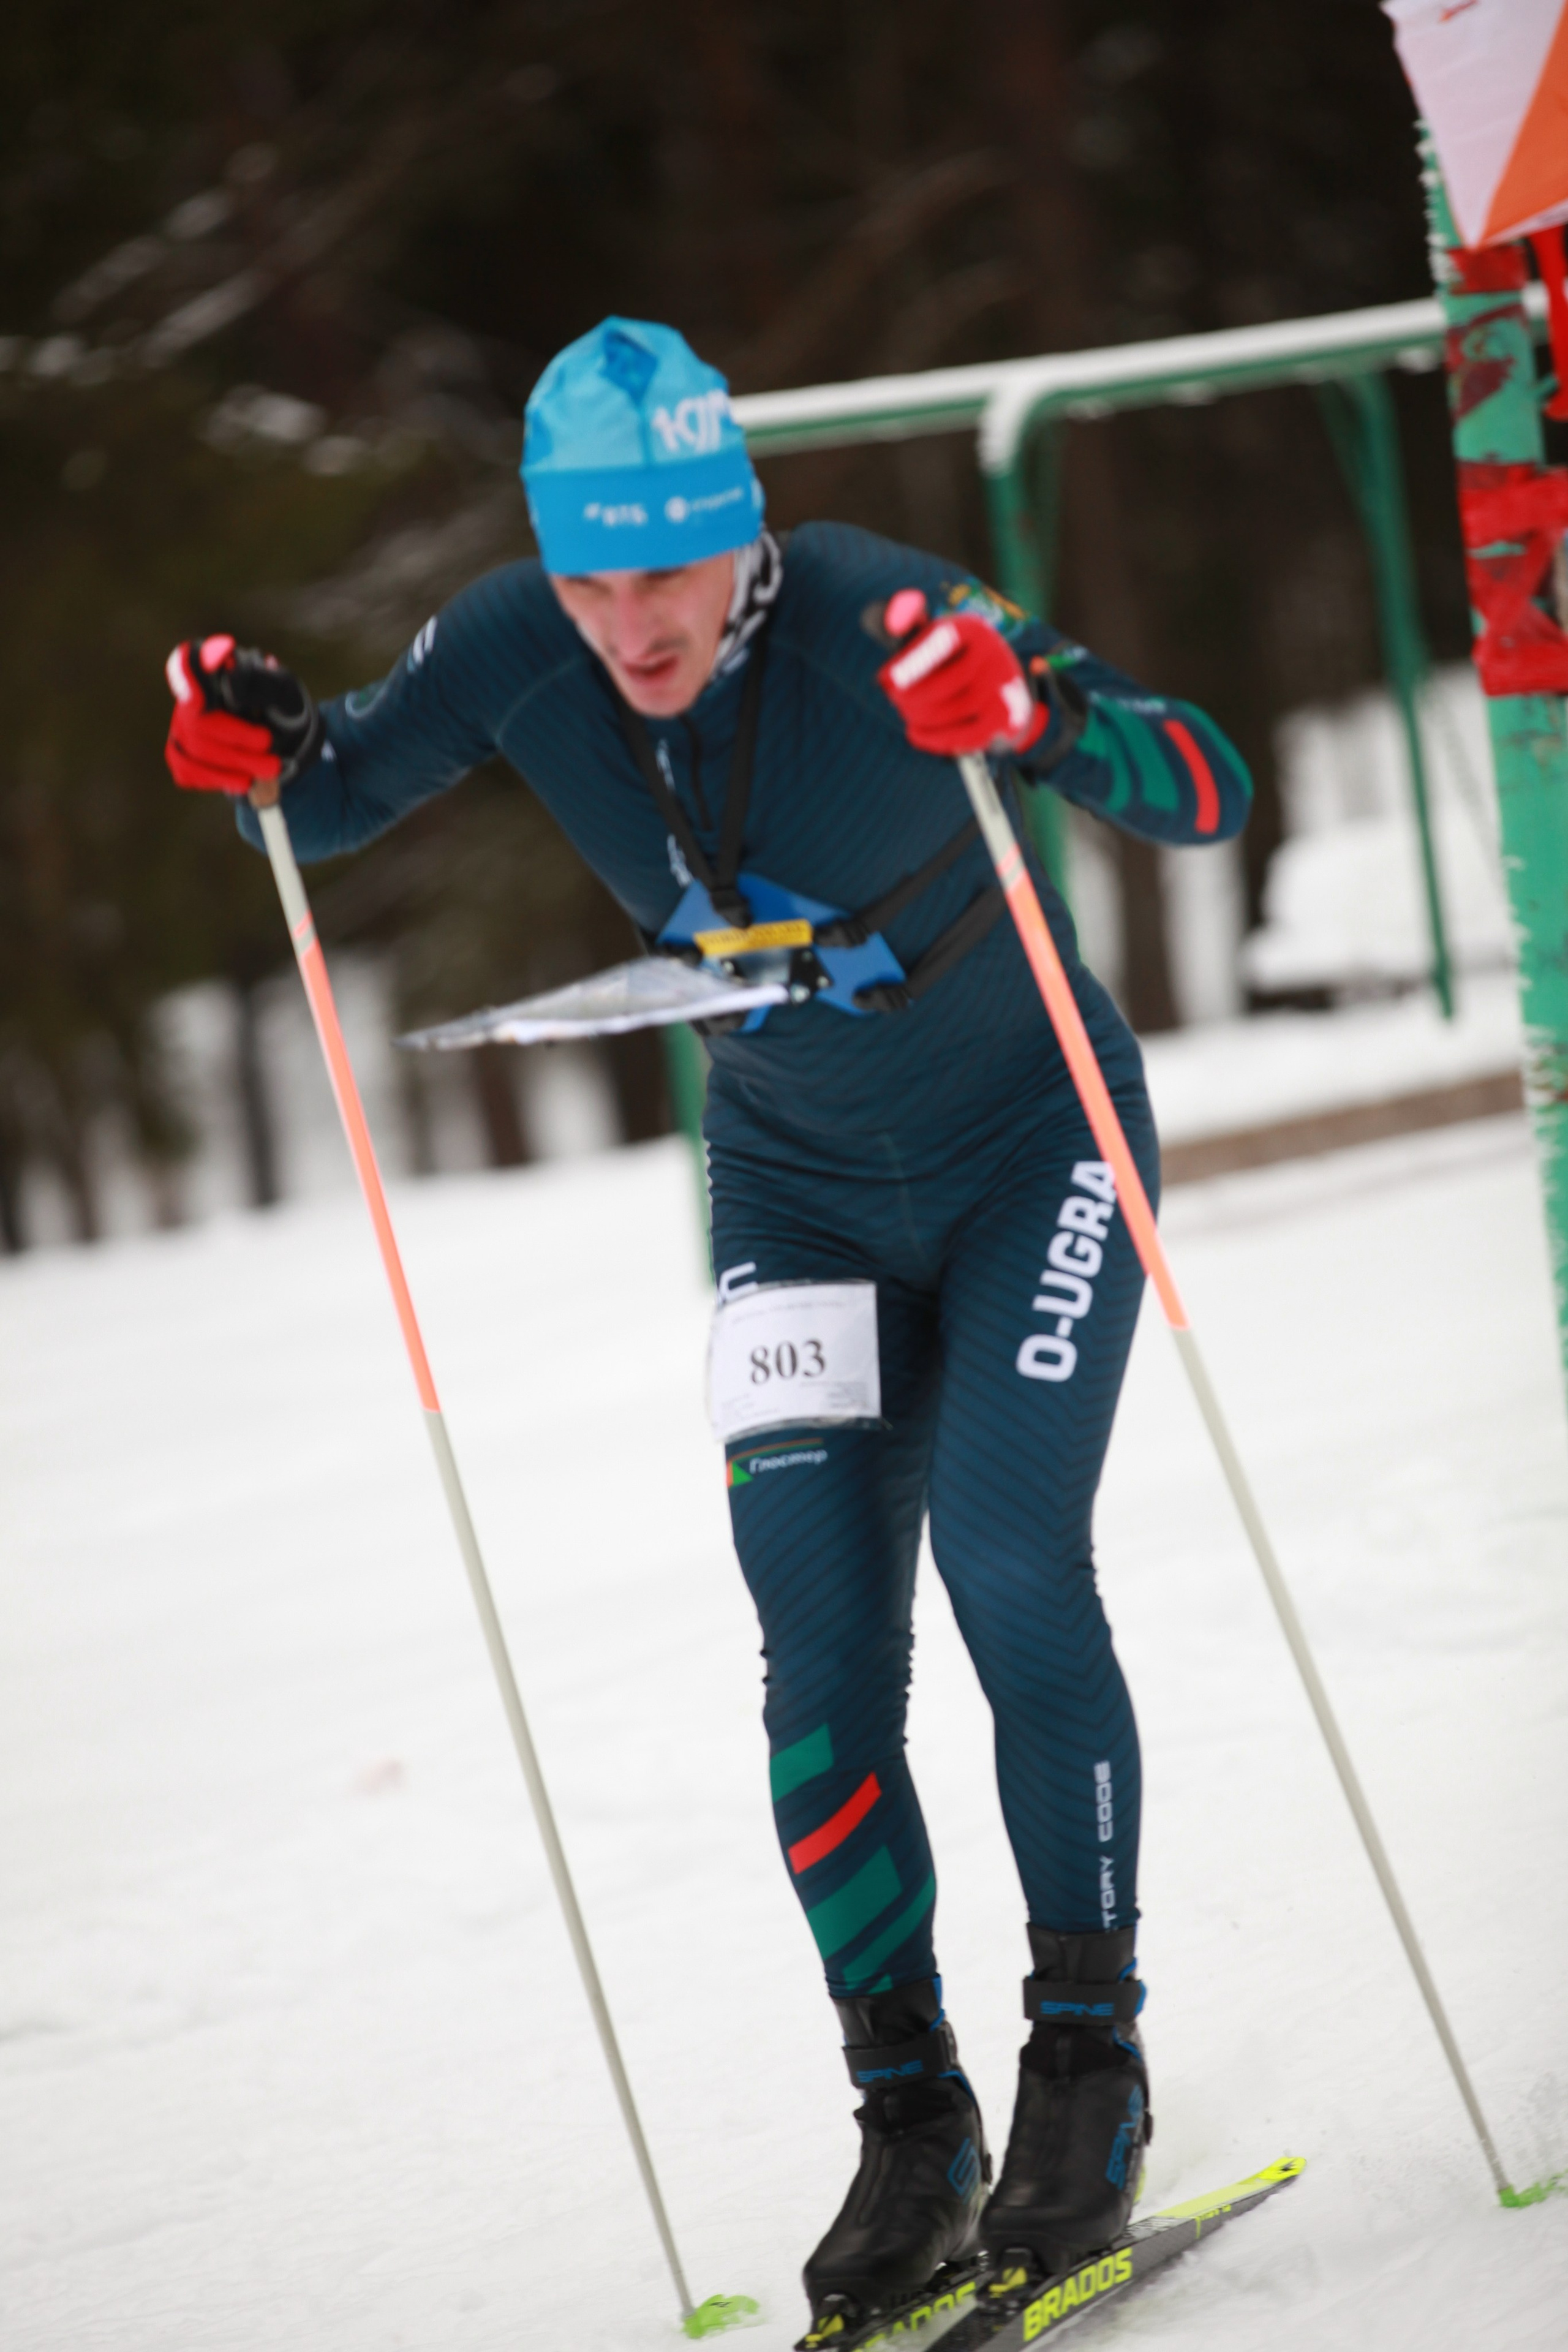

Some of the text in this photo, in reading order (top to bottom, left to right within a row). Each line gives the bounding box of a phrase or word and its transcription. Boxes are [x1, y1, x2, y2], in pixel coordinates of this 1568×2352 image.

[1015, 1160, 1117, 1383] O-UGRA
[750, 1337, 827, 1386] 803
[1099, 1855, 1118, 1931] TORY
[1023, 2246, 1133, 2342] BRADOS
